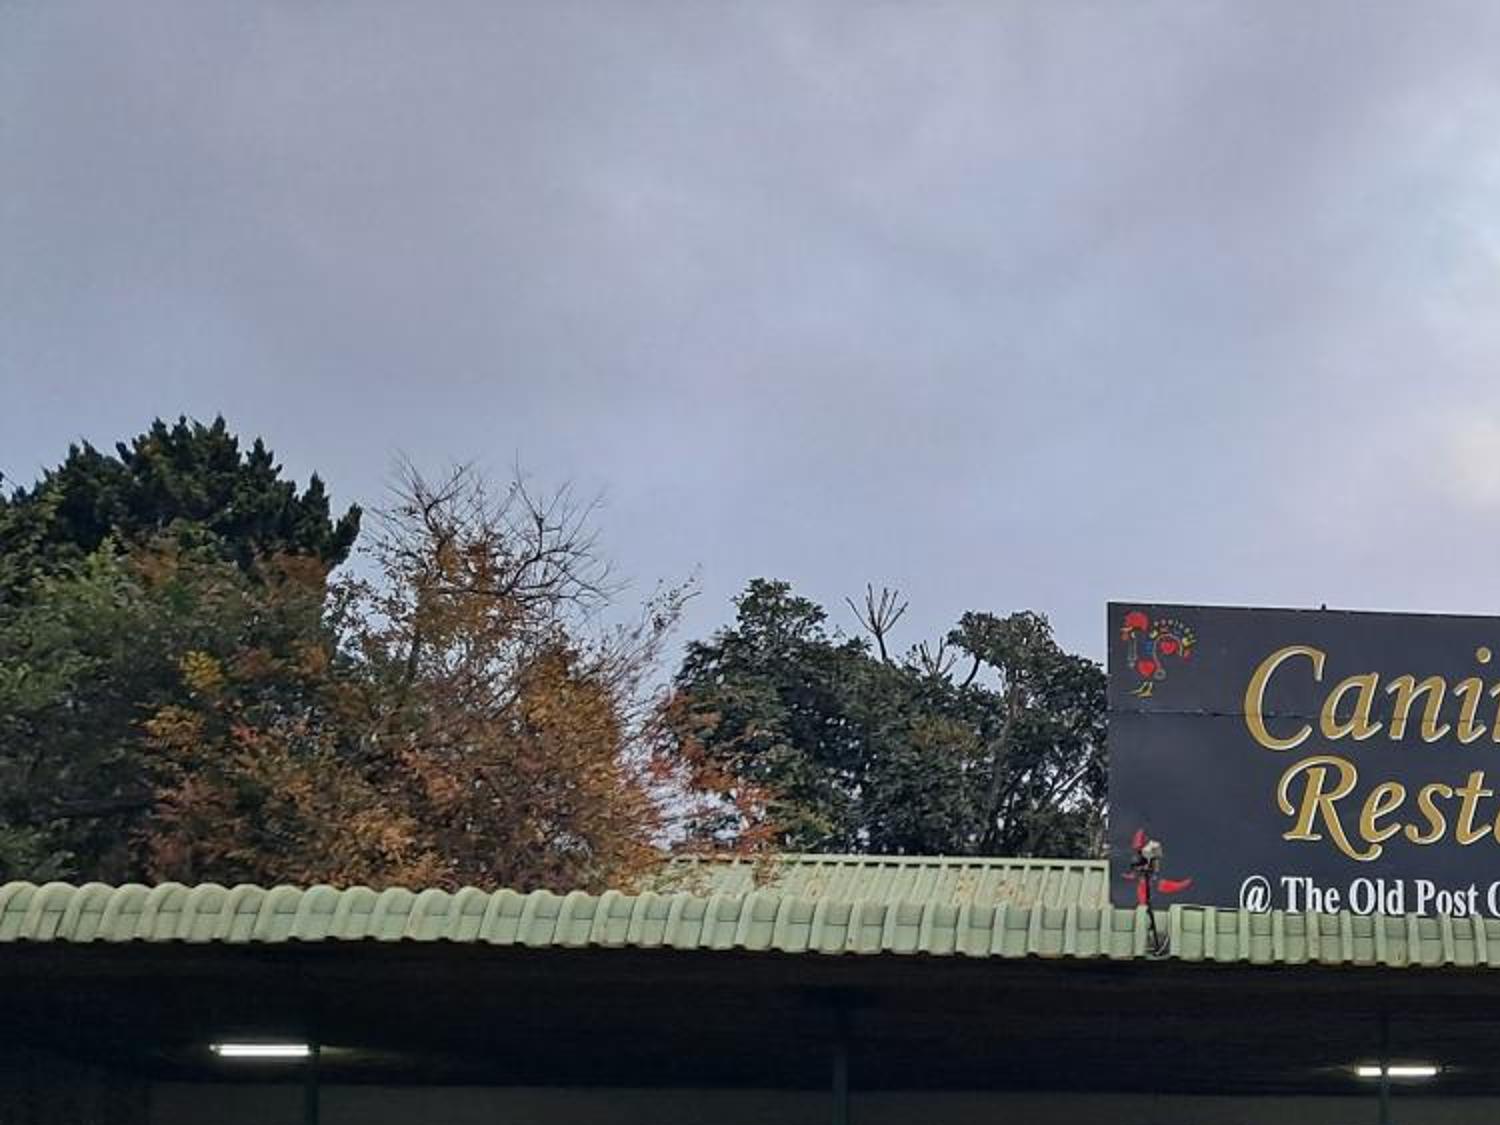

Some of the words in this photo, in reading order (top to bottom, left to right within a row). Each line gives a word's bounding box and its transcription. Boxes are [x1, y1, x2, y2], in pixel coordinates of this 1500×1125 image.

[1240, 876, 1271, 913] @
[1281, 877, 1341, 914] The
[1349, 878, 1404, 915] Old
[1415, 880, 1479, 917] Post
